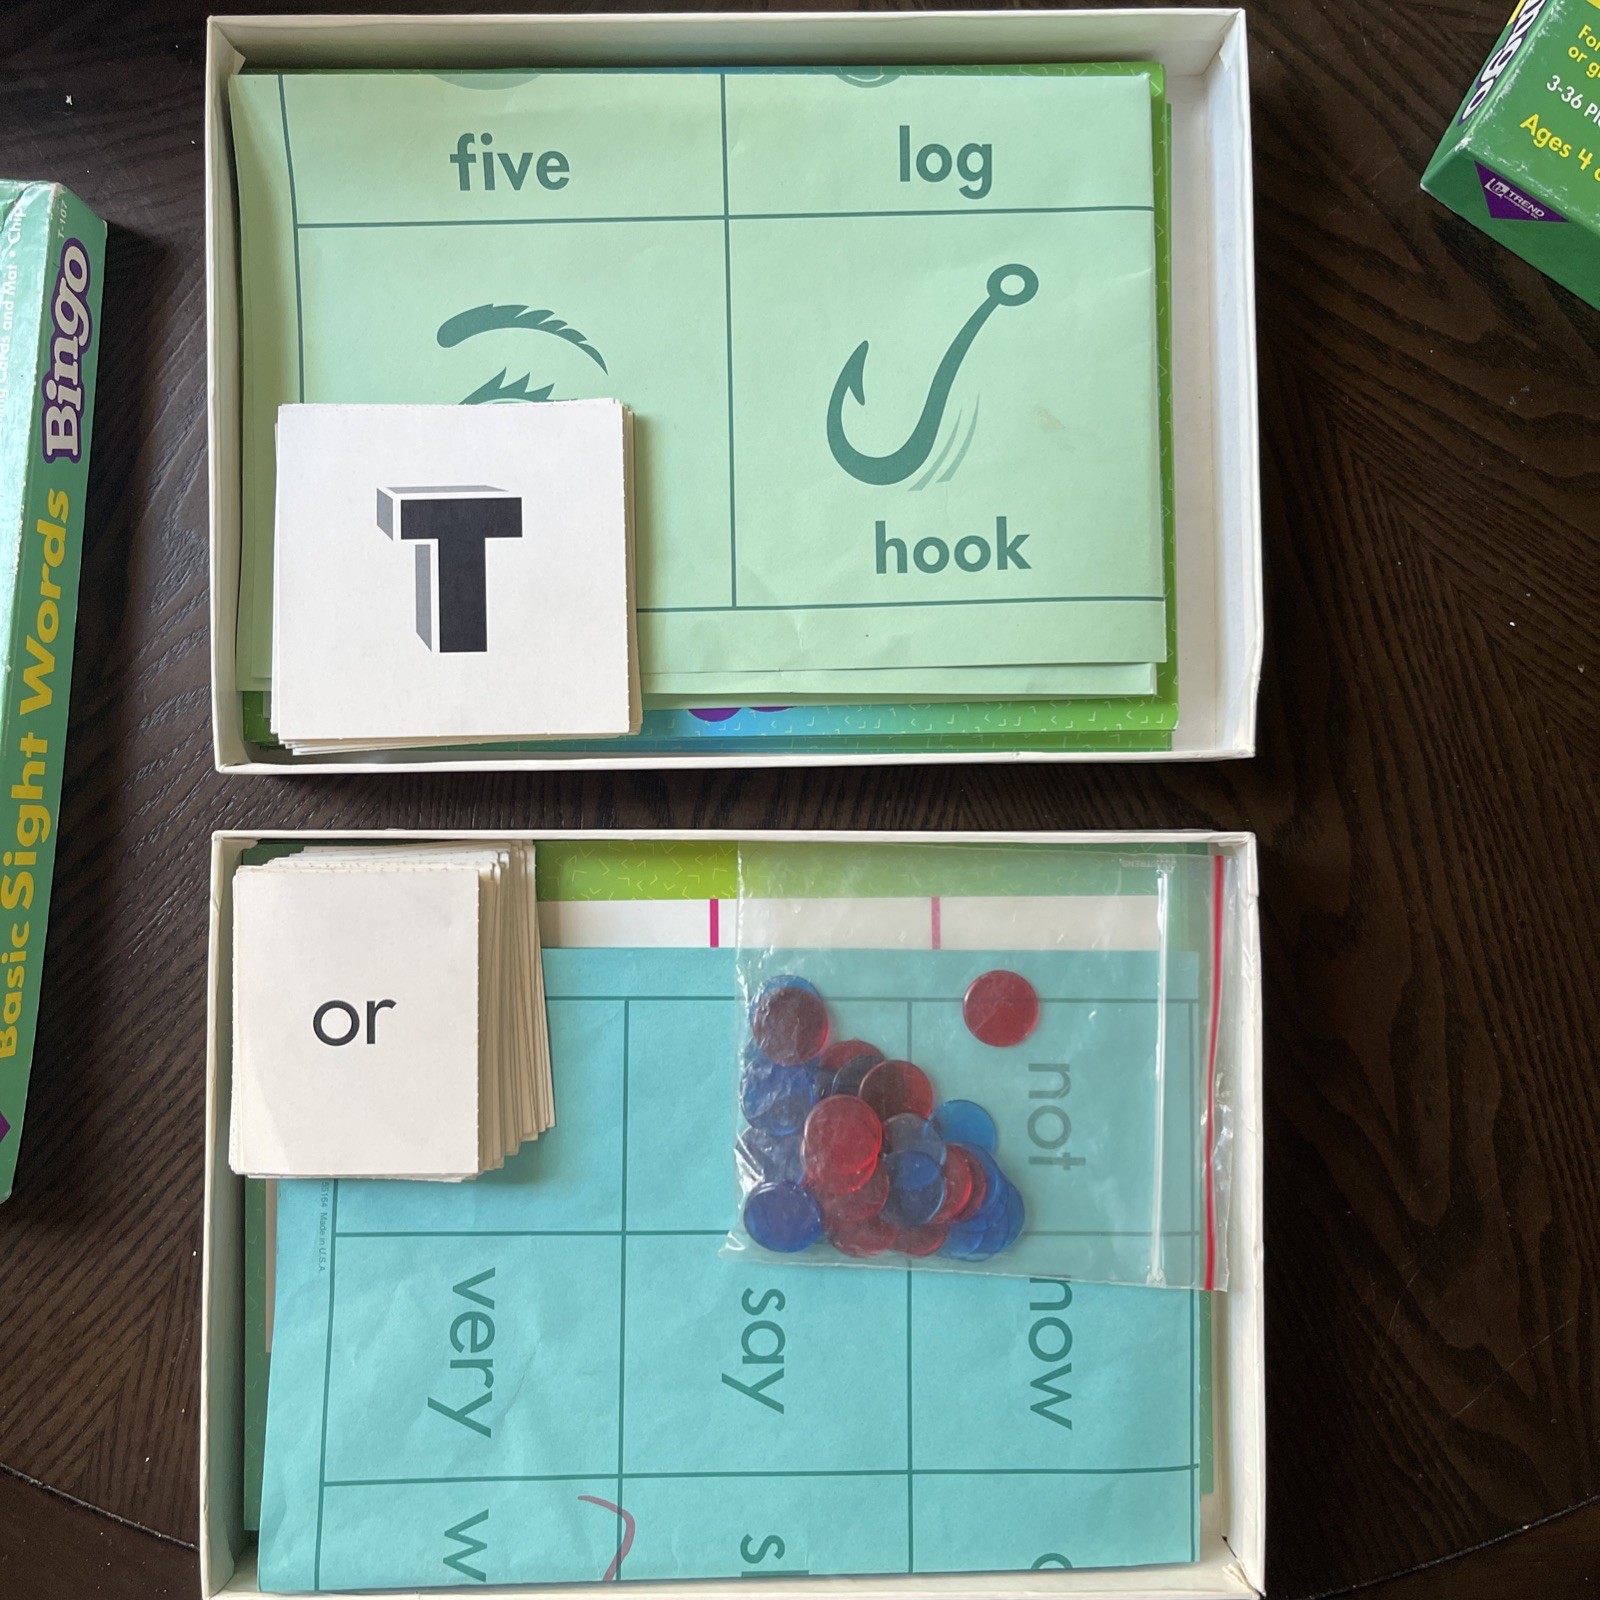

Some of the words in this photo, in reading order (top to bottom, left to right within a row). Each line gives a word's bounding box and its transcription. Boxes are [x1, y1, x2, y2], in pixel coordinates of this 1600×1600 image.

[1568, 46, 1588, 62] or
[1547, 74, 1584, 109] 3-36
[1584, 102, 1600, 127] Pl
[449, 132, 571, 191] five
[899, 124, 993, 200] log
[1520, 113, 1572, 158] Ages
[1578, 147, 1593, 171] 4
[57, 200, 68, 239] T-107
[1508, 190, 1545, 217] TREND
[4, 264, 18, 298] Mat
[45, 243, 90, 459] Bingo
[377, 485, 522, 653] T
[875, 515, 1032, 575] hook
[20, 488, 69, 715] Words
[2, 731, 52, 909] Sight
[0, 921, 30, 1058] Basic
[312, 998, 397, 1047] or
[1027, 1063, 1086, 1171] not
[319, 1213, 328, 1235] Made
[428, 1266, 496, 1439] very
[721, 1286, 785, 1415] say
[1028, 1274, 1073, 1430] now
